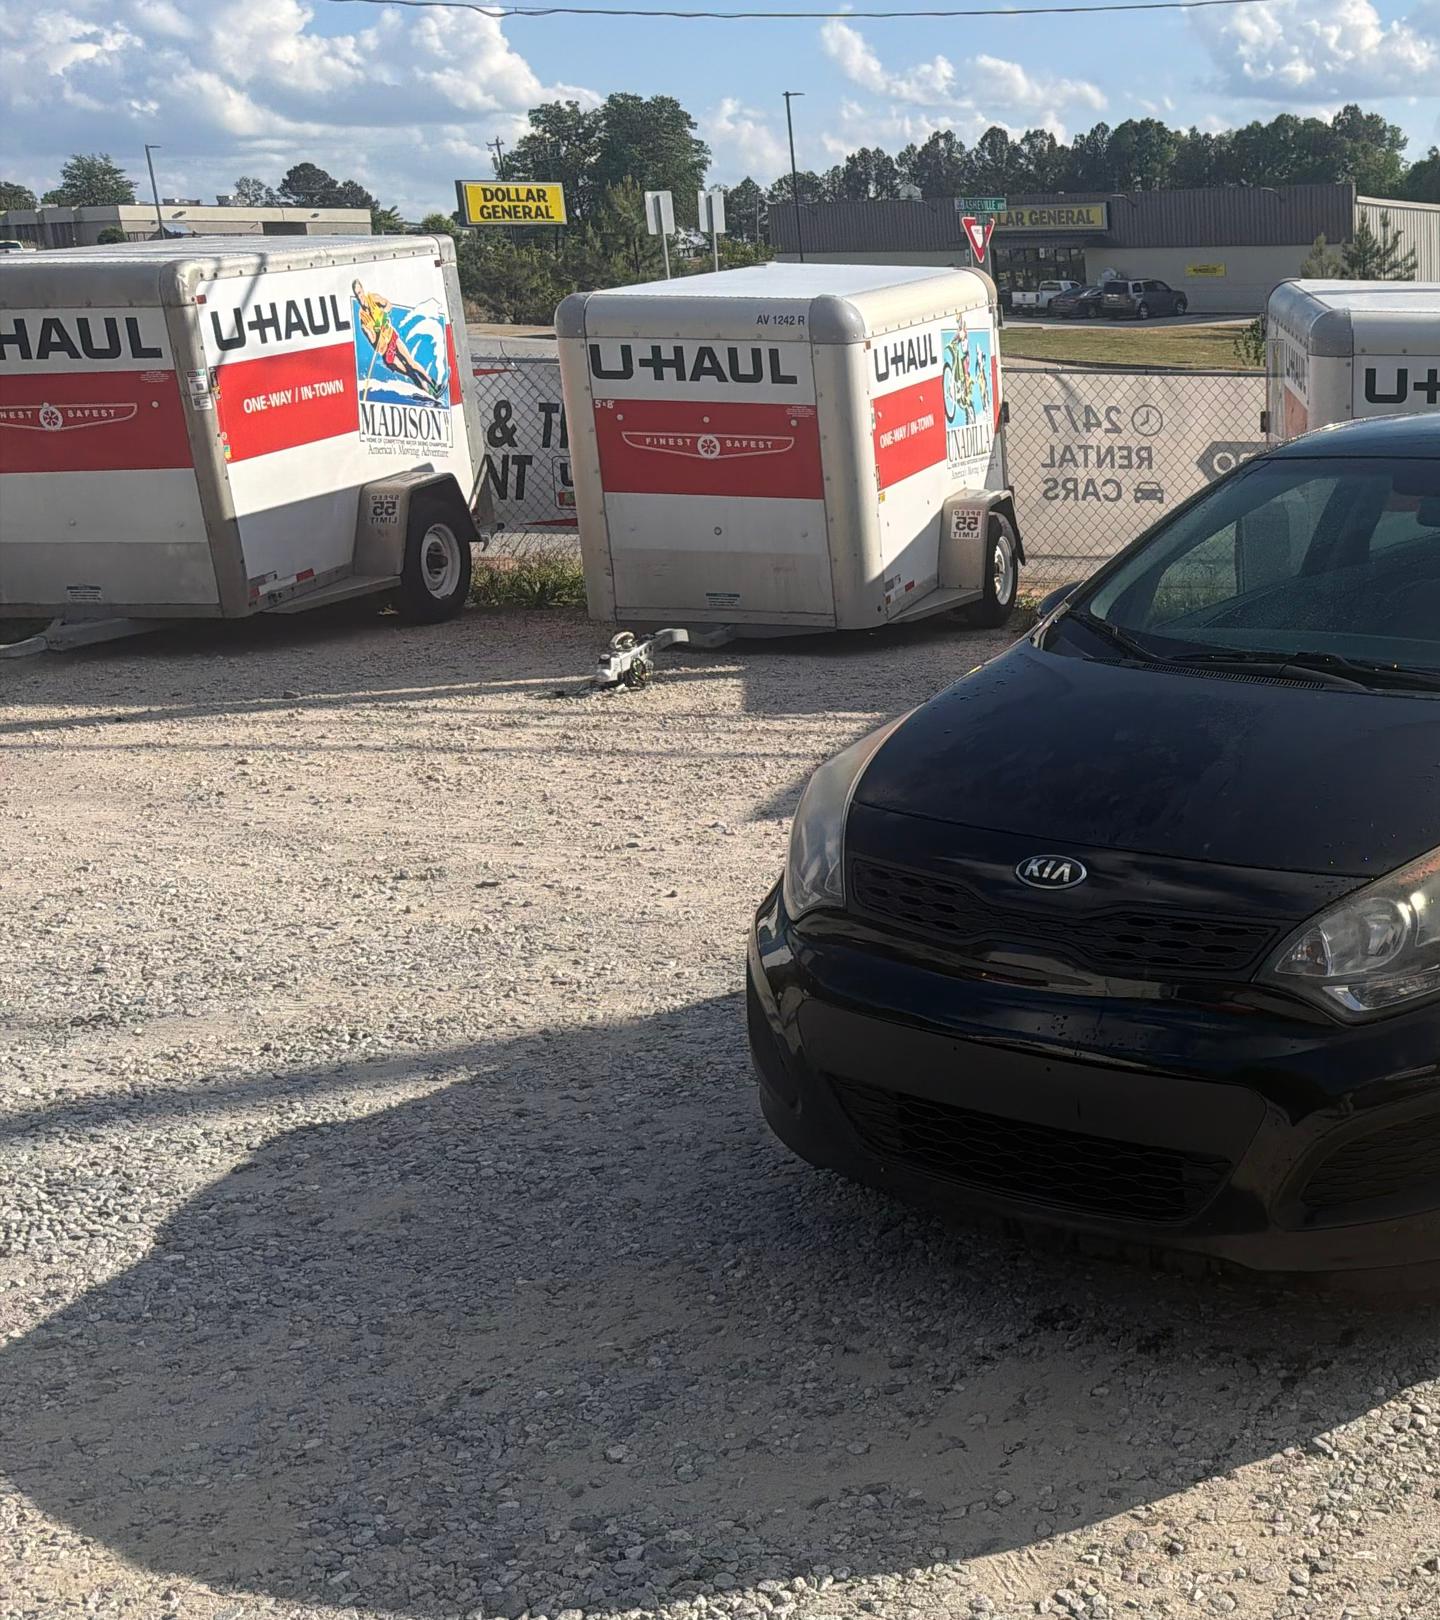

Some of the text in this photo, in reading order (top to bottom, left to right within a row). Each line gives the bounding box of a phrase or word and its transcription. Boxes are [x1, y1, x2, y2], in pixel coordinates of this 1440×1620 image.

[481, 187, 548, 203] DOLLAR
[480, 204, 554, 219] GENERAL
[1029, 209, 1095, 225] GENERAL
[210, 294, 351, 352] U-HAUL
[756, 315, 805, 326] AV 1242 R
[588, 343, 798, 385] U-HAUL
[873, 333, 938, 383] U-HAUL
[243, 390, 292, 414] ONE-WAY
[301, 379, 345, 400] IN-TOWN
[67, 409, 116, 418] SAFEST
[360, 403, 442, 440] MADISON
[487, 400, 518, 448] &
[645, 437, 773, 449] FINEST SAFEST
[880, 424, 907, 449] ONE-WAY
[910, 413, 935, 436] IN-TOWN
[1024, 859, 1072, 882] KIA
